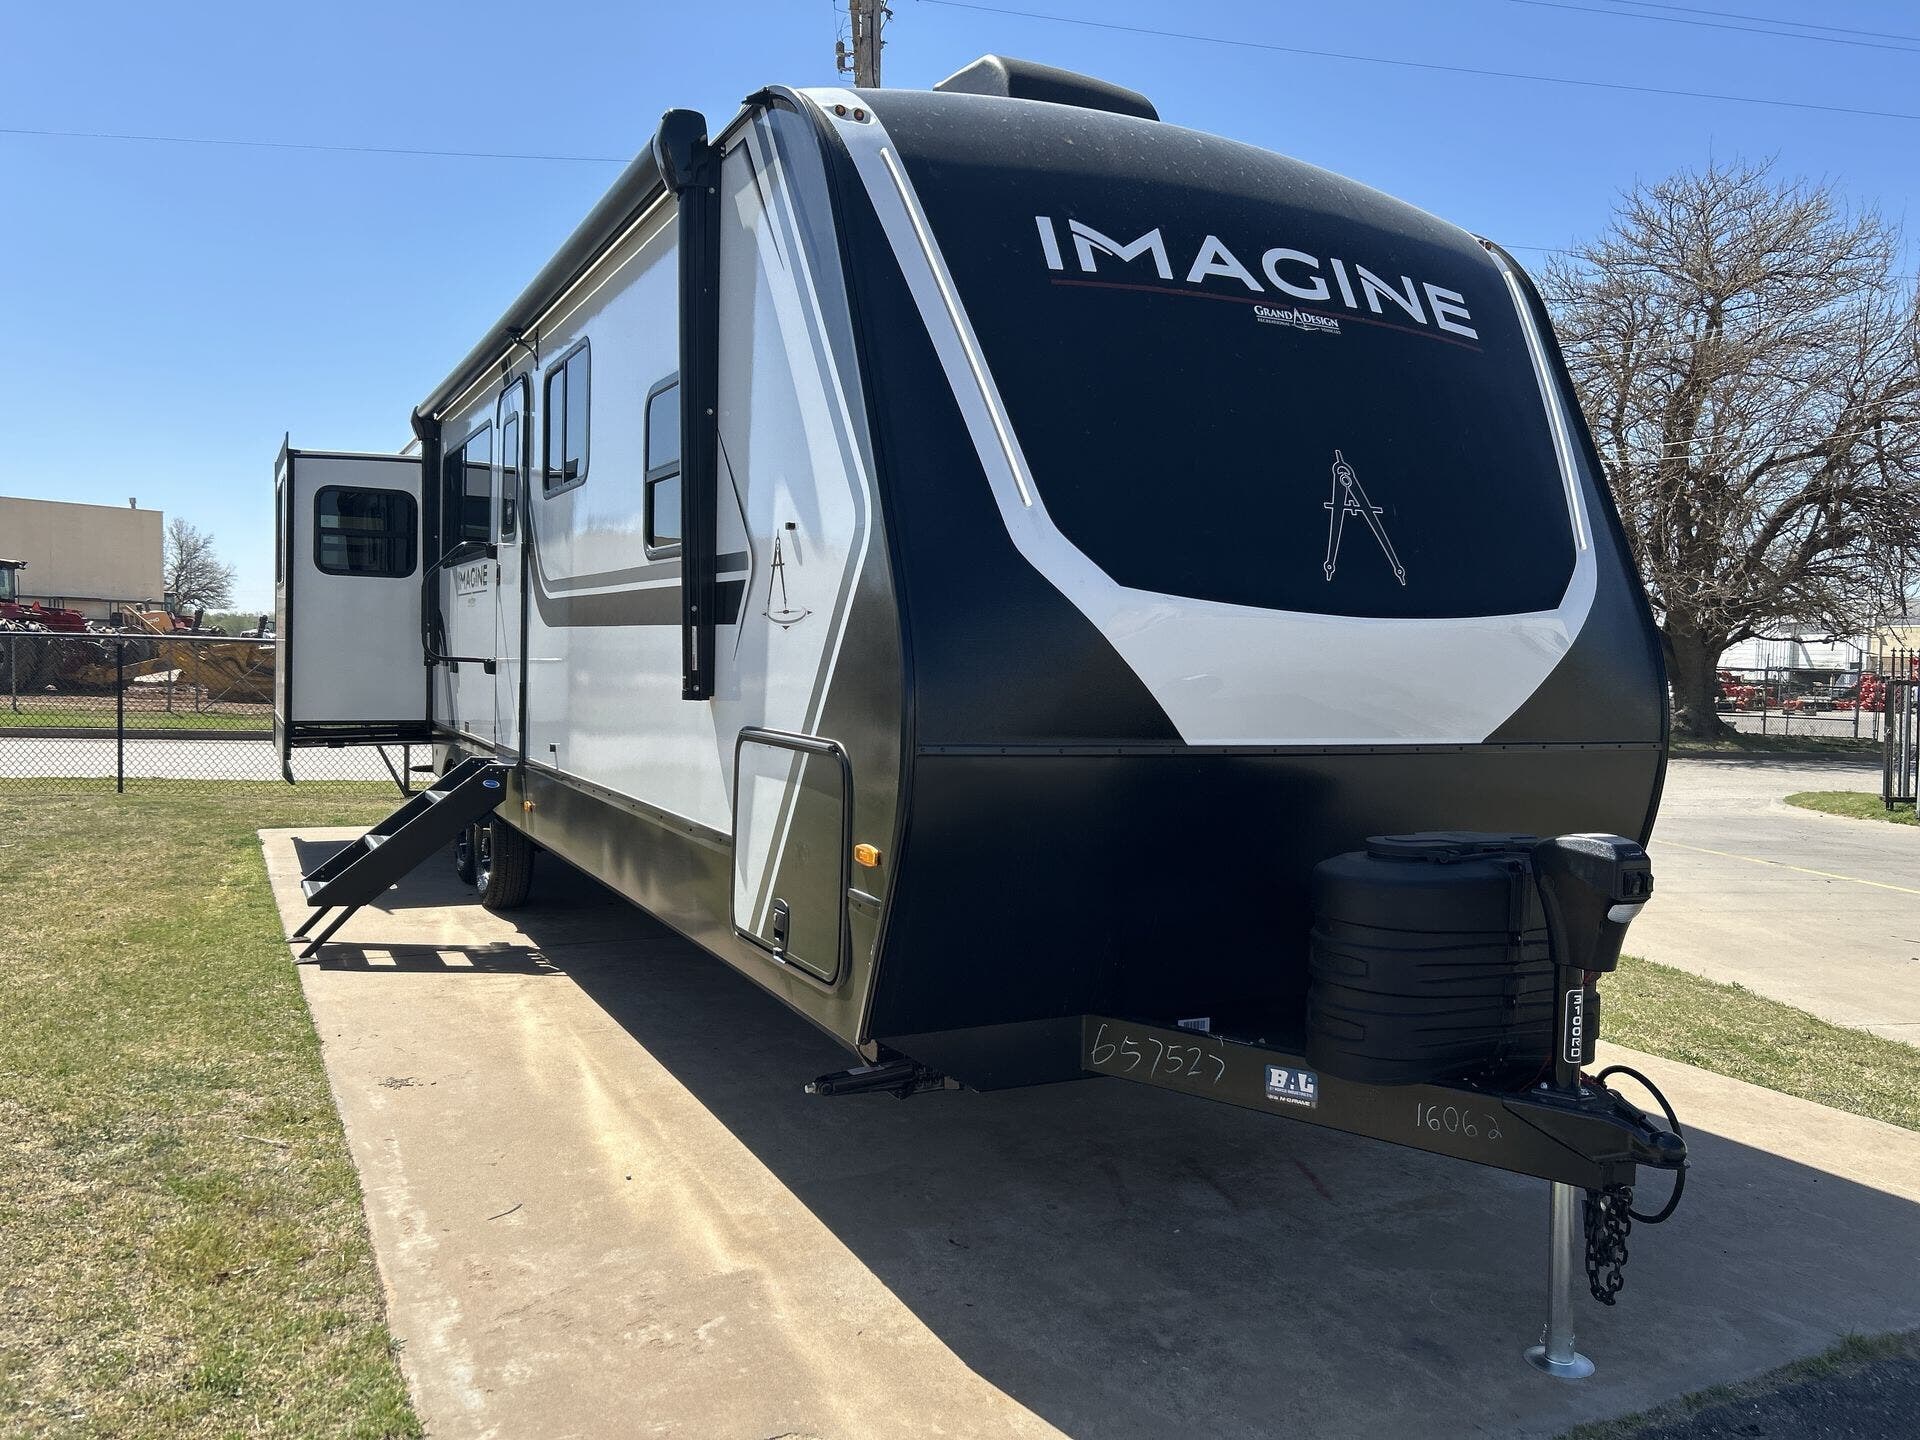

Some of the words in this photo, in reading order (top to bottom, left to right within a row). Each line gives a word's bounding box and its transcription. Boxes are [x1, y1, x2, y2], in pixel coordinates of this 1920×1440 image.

[1035, 215, 1479, 340] IMAGINE
[1254, 305, 1293, 320] GRAND
[1302, 312, 1339, 327] DESIGN
[1090, 1023, 1226, 1085] 657527
[1570, 994, 1582, 1058] 3100RD
[1417, 1102, 1502, 1140] 16062
